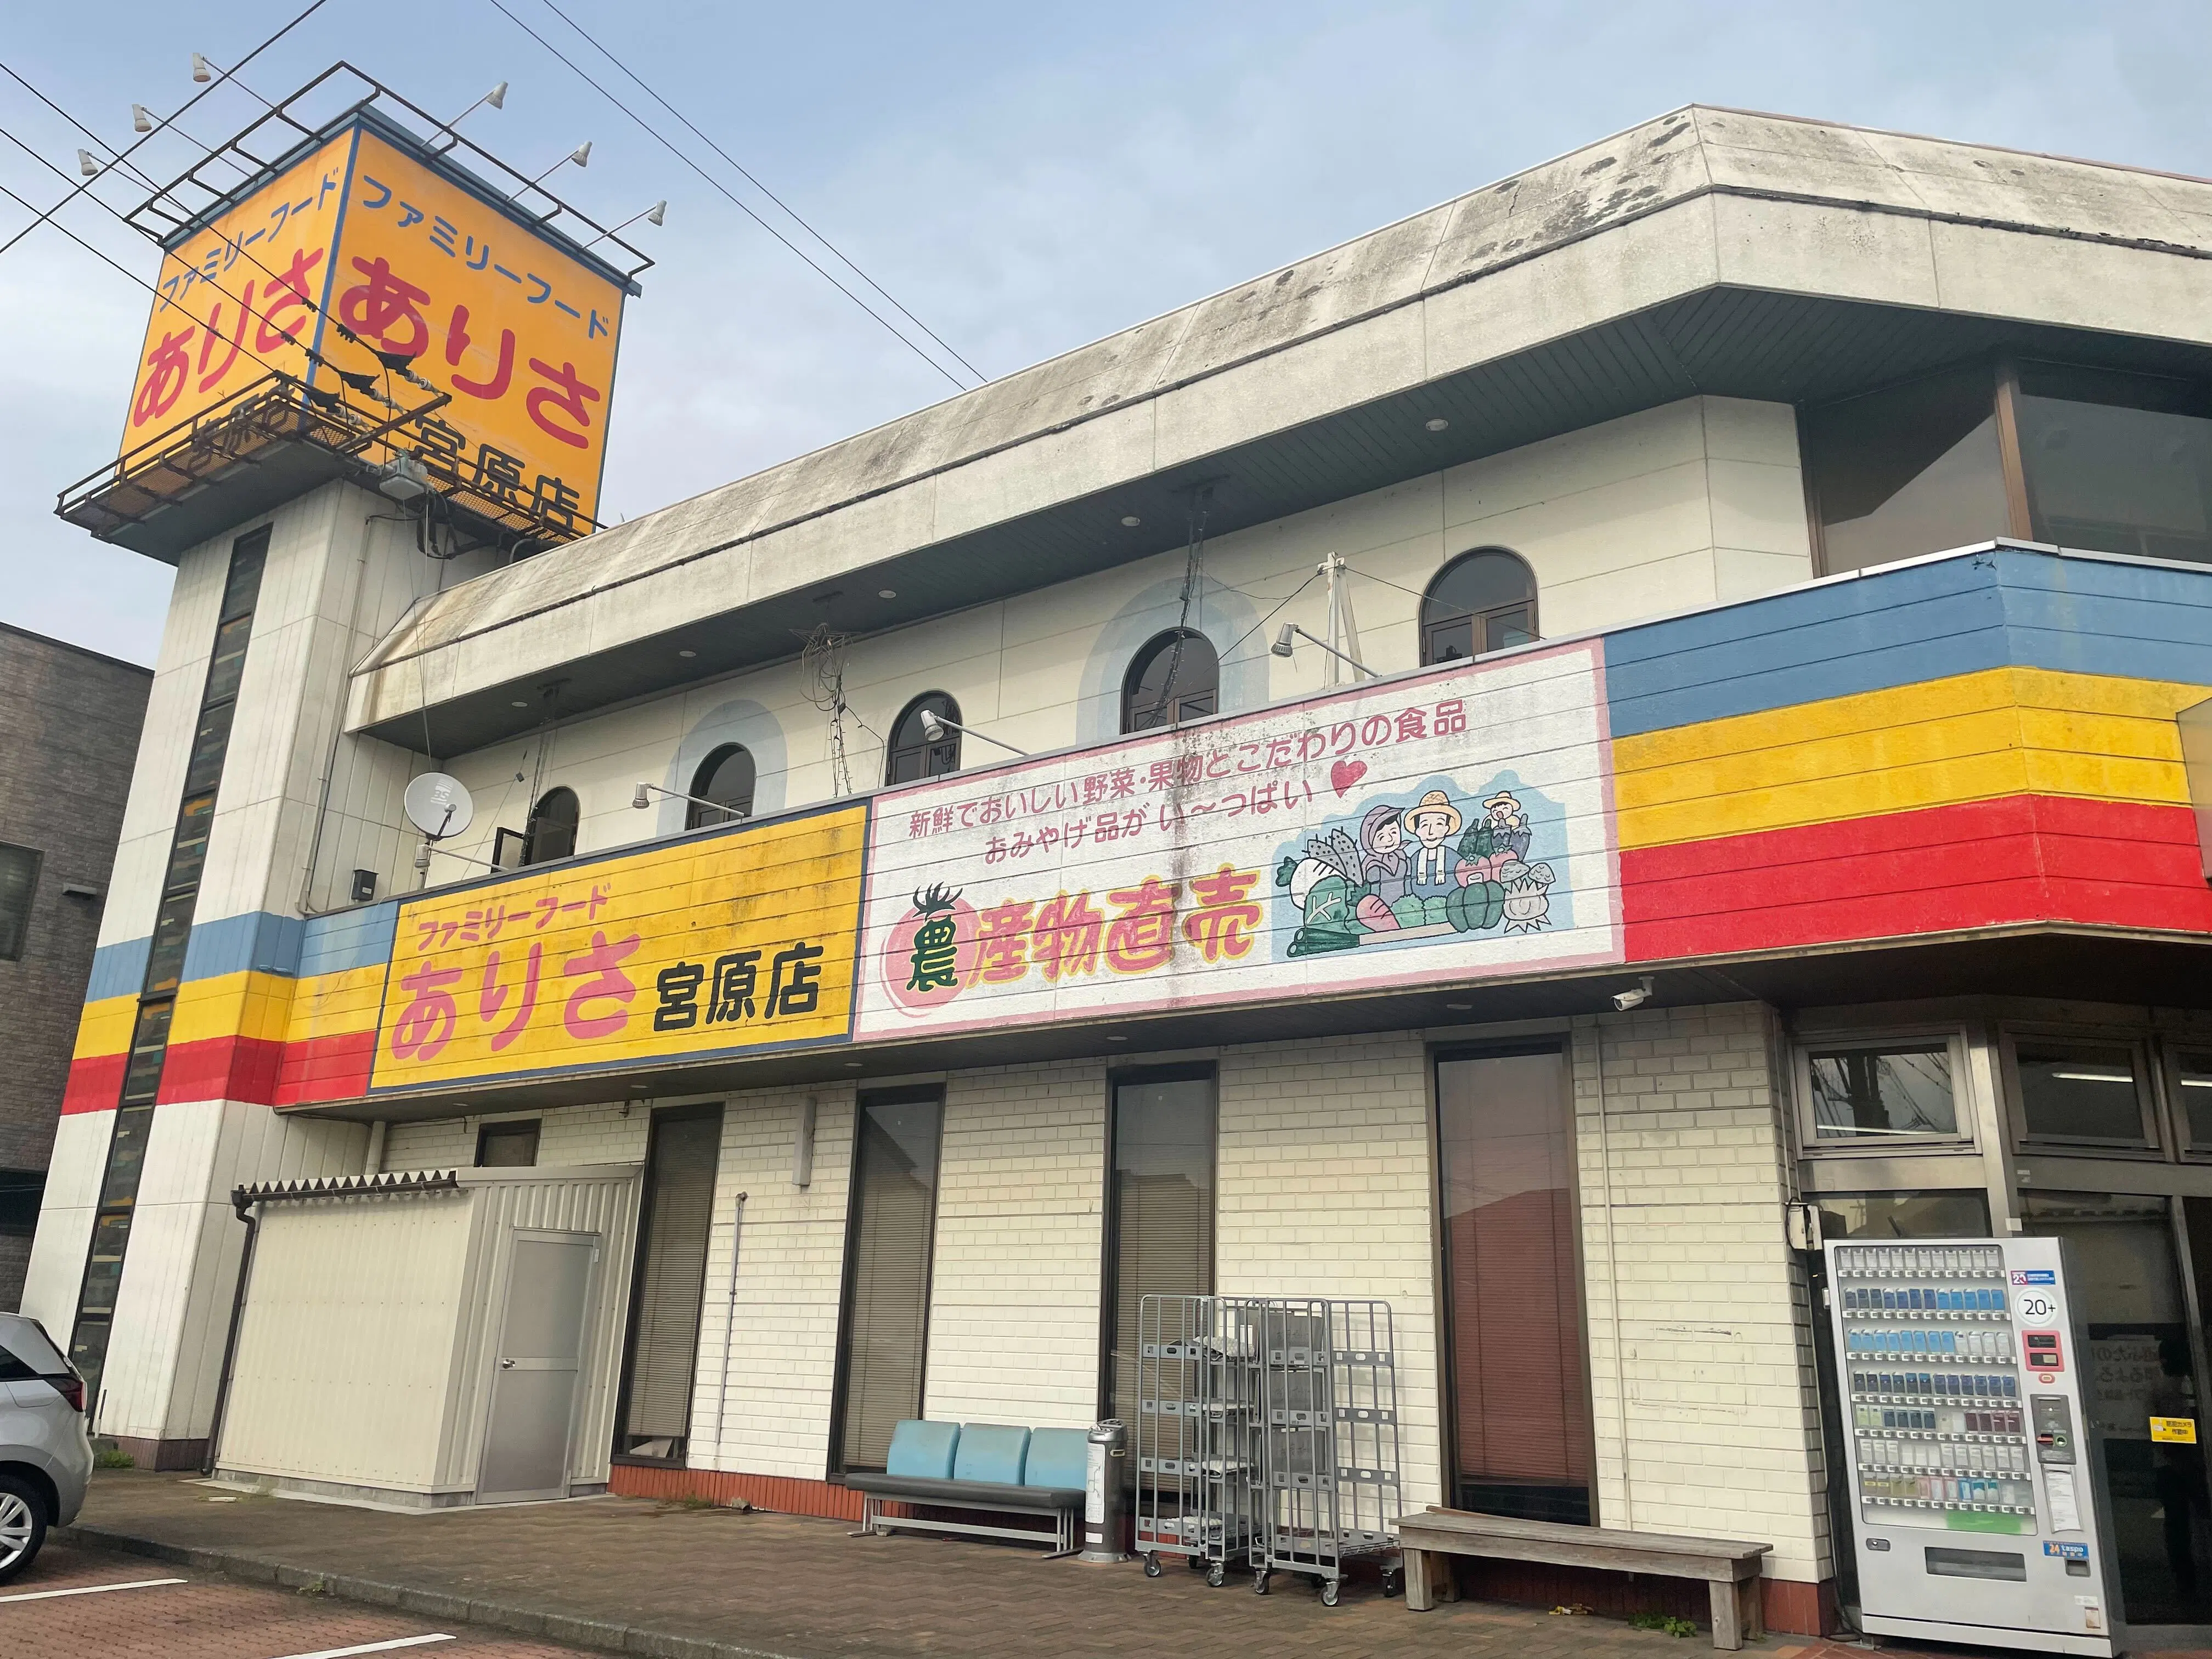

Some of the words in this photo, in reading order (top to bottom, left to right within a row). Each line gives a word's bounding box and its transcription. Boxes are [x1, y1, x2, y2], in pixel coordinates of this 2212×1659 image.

[159, 167, 338, 313] ファミリーフード
[363, 174, 610, 340] ファミリーフード
[133, 247, 324, 427] ありさ
[339, 256, 601, 449] ありさ
[414, 415, 580, 532] 宮原店
[417, 883, 612, 952] ファミリーフード
[906, 864, 1261, 992] 農産物直売
[391, 930, 640, 1062] ありさ
[654, 941, 825, 1031] 宮原店
[2024, 1299, 2056, 1315] 20+
